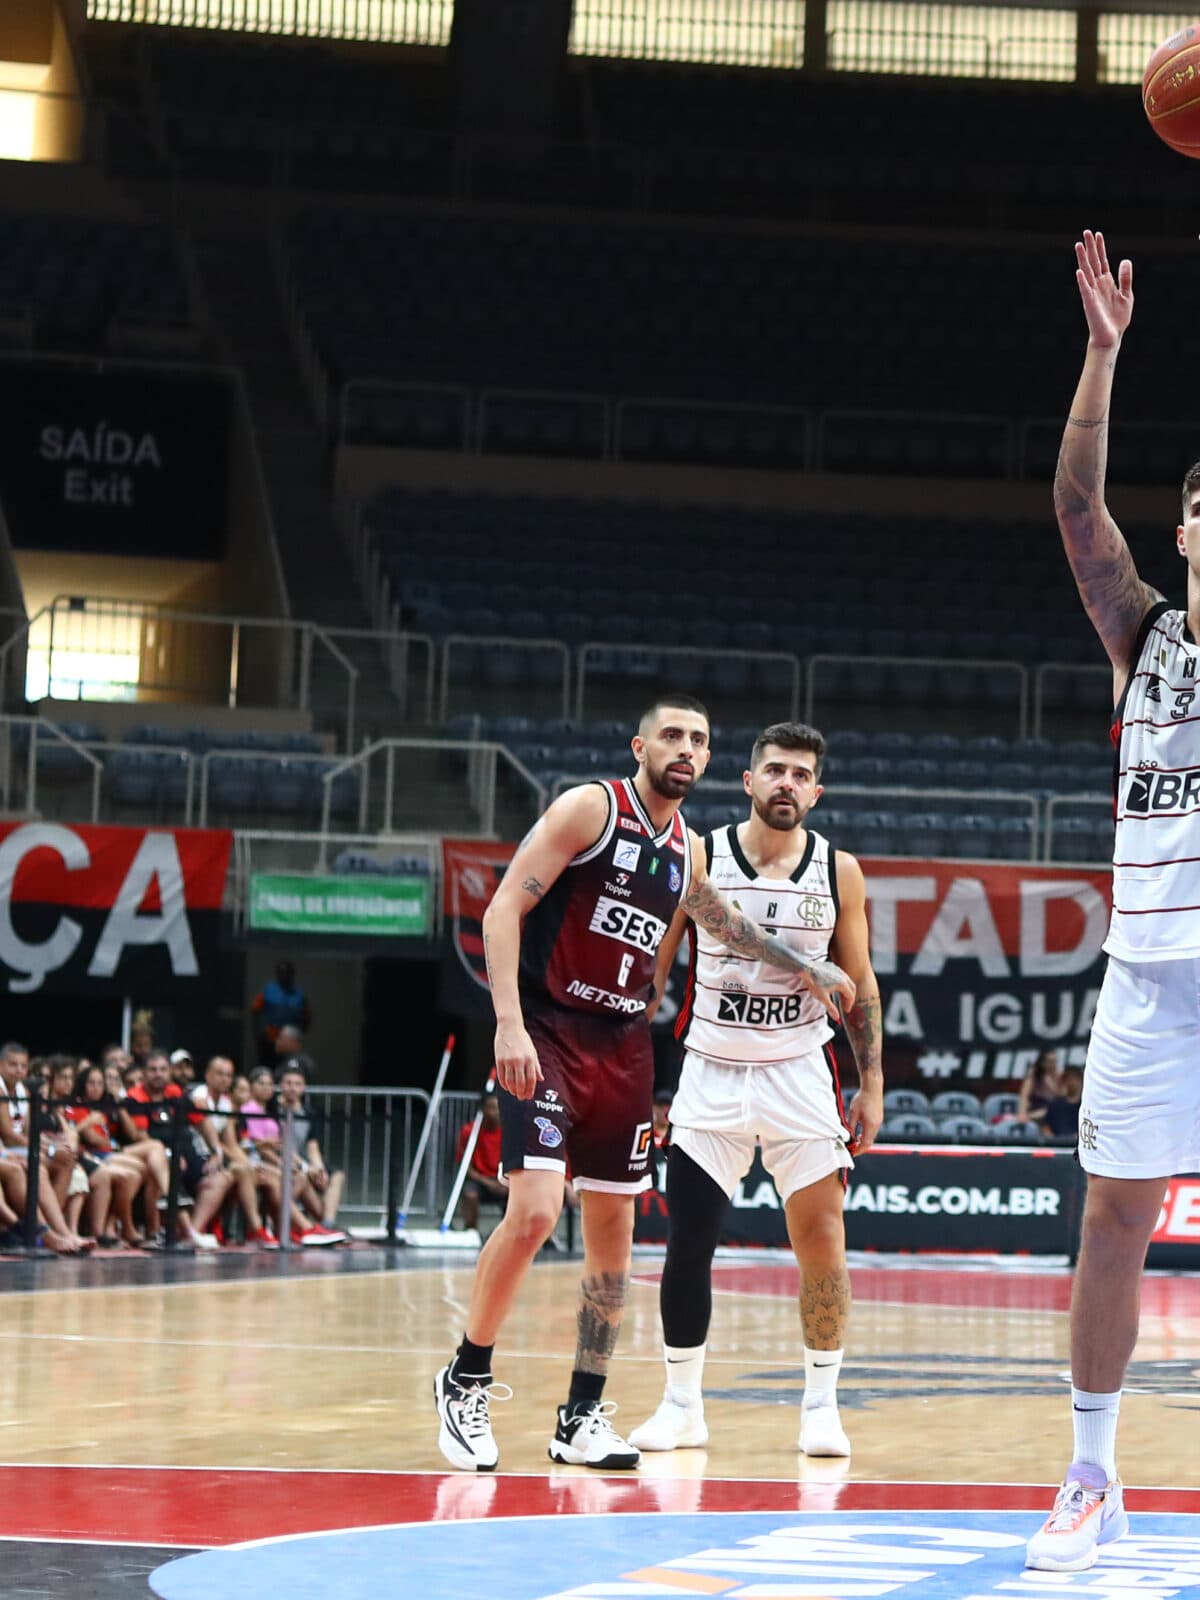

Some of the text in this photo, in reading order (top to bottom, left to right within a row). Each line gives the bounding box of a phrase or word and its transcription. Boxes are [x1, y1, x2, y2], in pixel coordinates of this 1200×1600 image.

[40, 420, 161, 467] SAÍDA
[64, 469, 133, 505] Exit
[1171, 692, 1195, 719] 9
[604, 881, 632, 898] Topper
[0, 822, 199, 993] ÇA
[746, 995, 802, 1025] BRB
[843, 1185, 1060, 1215] AIS.COM.BR
